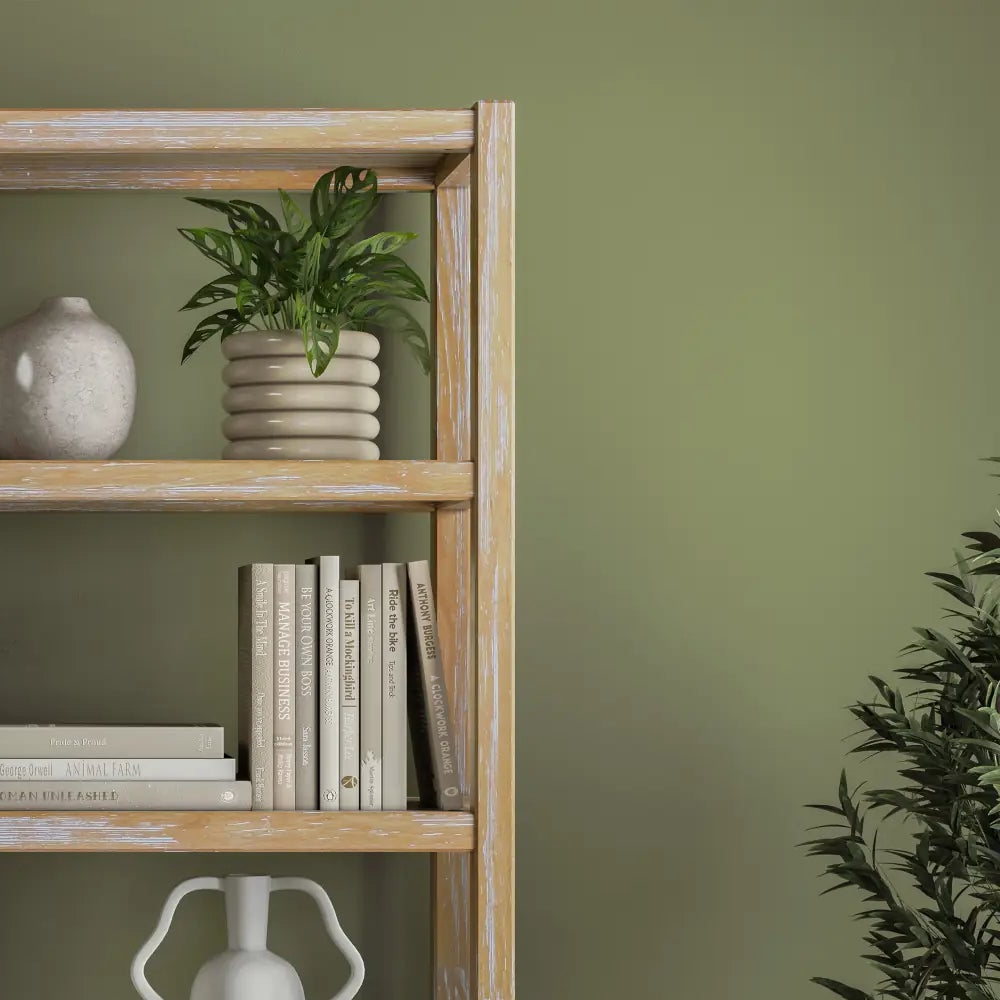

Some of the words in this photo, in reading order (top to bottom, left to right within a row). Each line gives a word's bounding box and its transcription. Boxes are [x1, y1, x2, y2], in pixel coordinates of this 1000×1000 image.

[301, 587, 313, 600] BE
[344, 597, 355, 610] To
[367, 597, 376, 611] Art
[388, 589, 399, 611] Ride
[416, 583, 431, 621] ANTHONY
[301, 603, 312, 633] YOUR
[325, 595, 334, 636] CLOCKWORK
[344, 613, 356, 629] Kill
[388, 613, 398, 630] the
[278, 602, 291, 656] MANAGE
[423, 624, 436, 659] BURGESS
[300, 635, 313, 666] OWN
[325, 639, 334, 666] ORANGE
[388, 632, 398, 652] bike
[342, 640, 356, 701] Mockingbird
[278, 660, 290, 720] BUSINESS
[301, 671, 313, 696] BOSS
[50, 737, 71, 746] Pride
[73, 738, 81, 746] &
[82, 737, 107, 746] Proud
[431, 684, 448, 738] CLOCKWORK
[440, 740, 454, 775] ORANGE
[0, 763, 27, 779] George
[28, 763, 53, 776] Orwell
[112, 761, 141, 777] FARM
[42, 791, 120, 801] UNLEASHED
